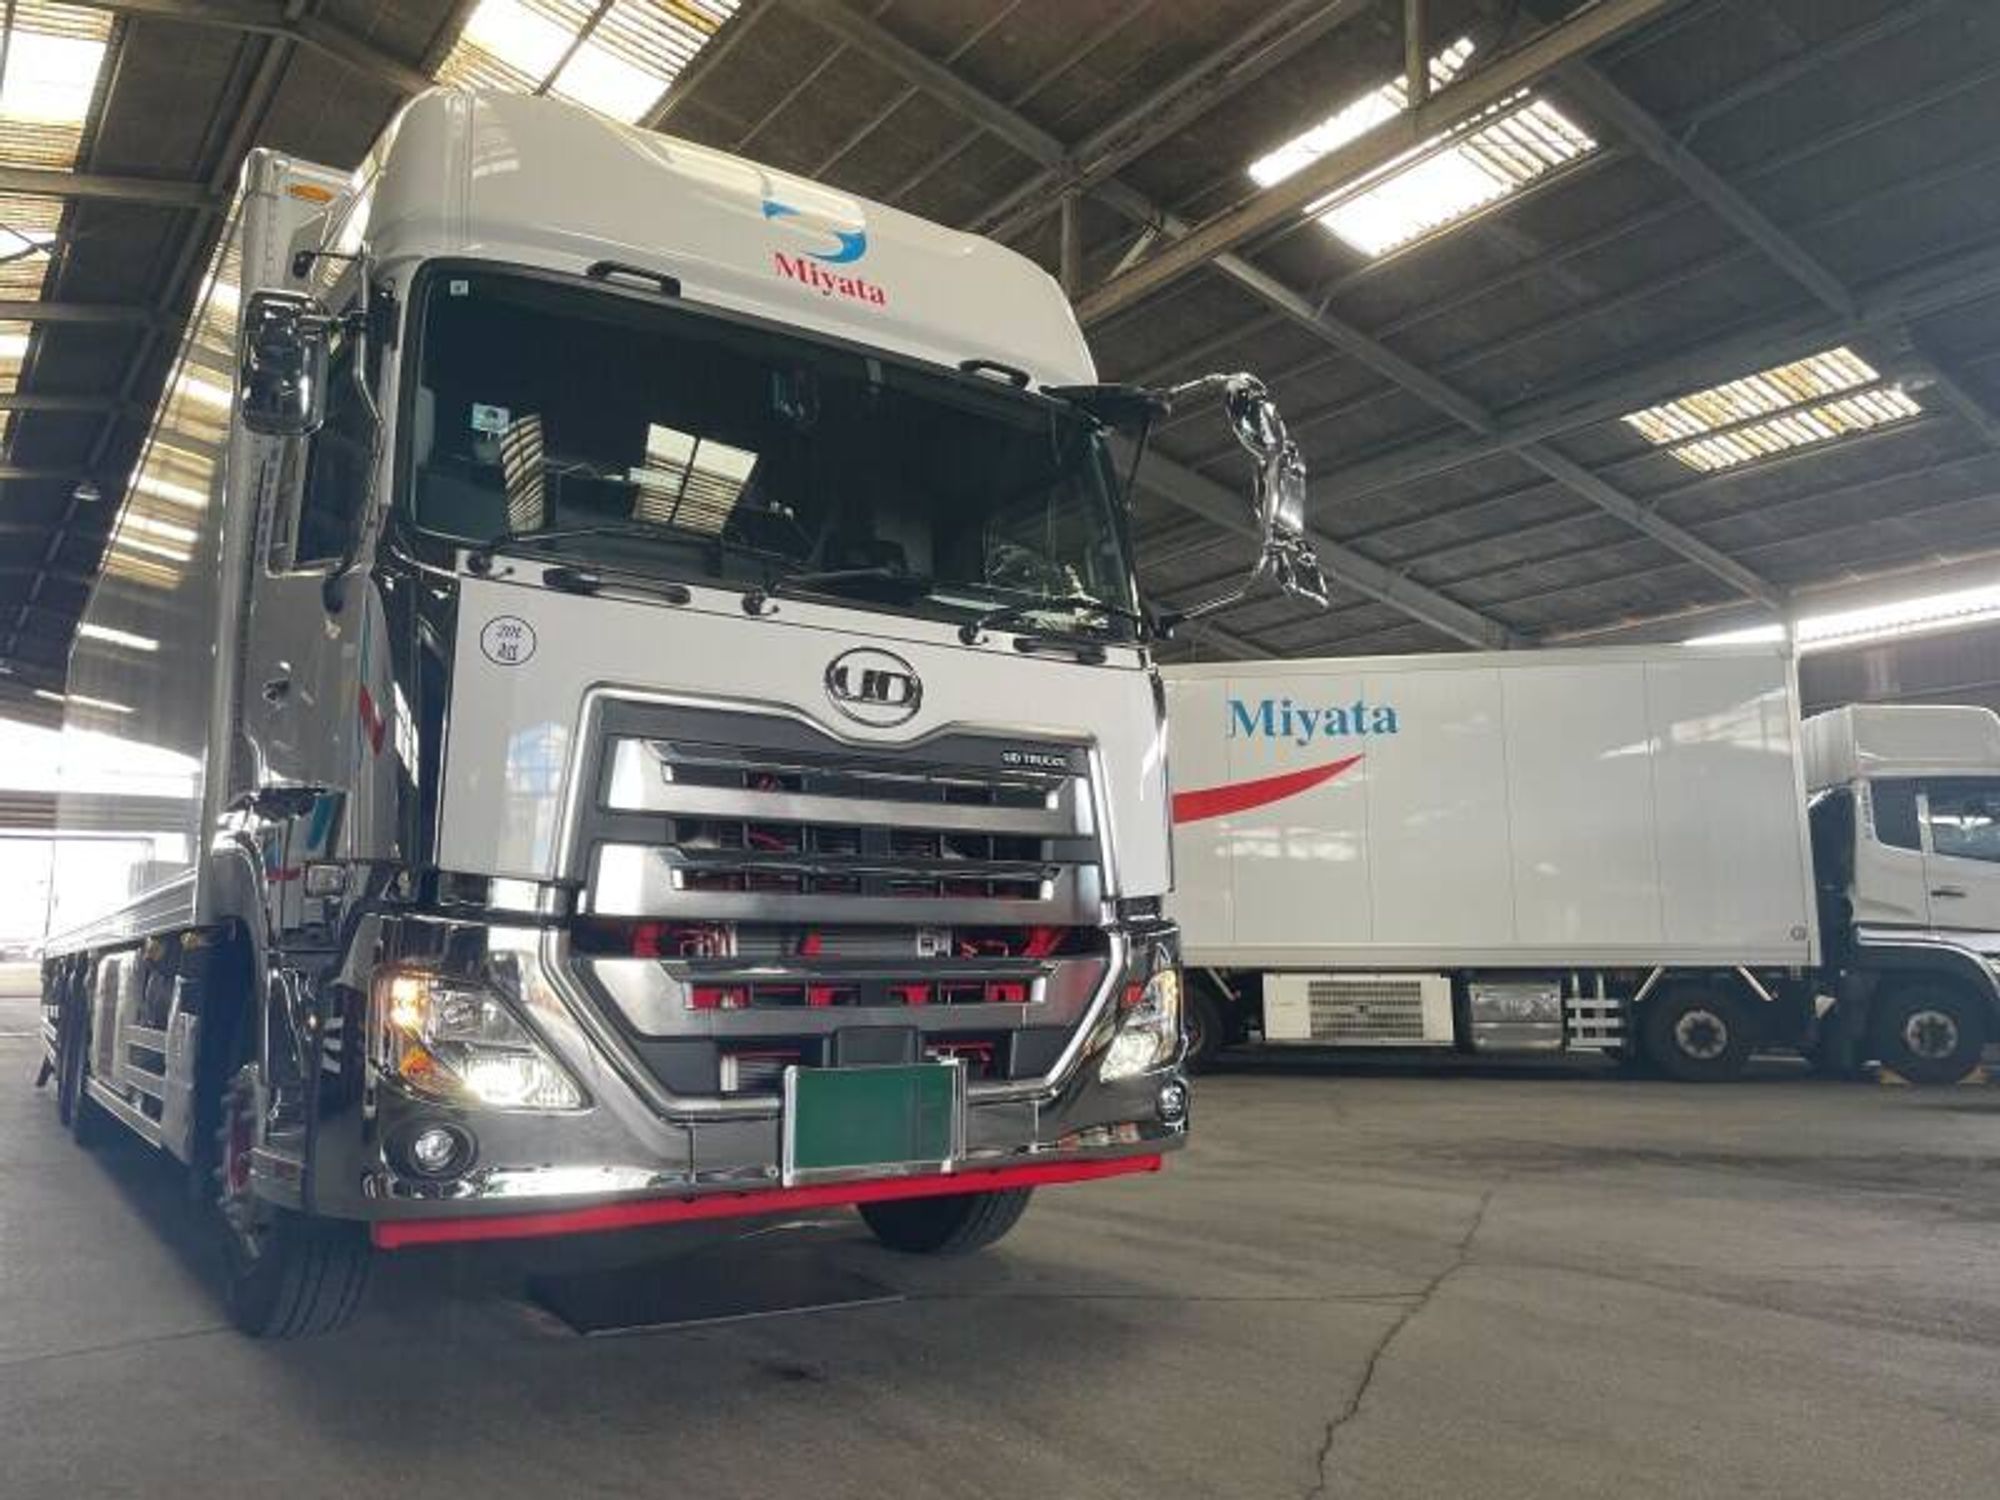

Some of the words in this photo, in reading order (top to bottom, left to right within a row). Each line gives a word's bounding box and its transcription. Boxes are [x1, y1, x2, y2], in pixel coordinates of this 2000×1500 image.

[775, 250, 885, 305] Miyata
[831, 666, 915, 706] UD
[1226, 698, 1398, 746] Miyata
